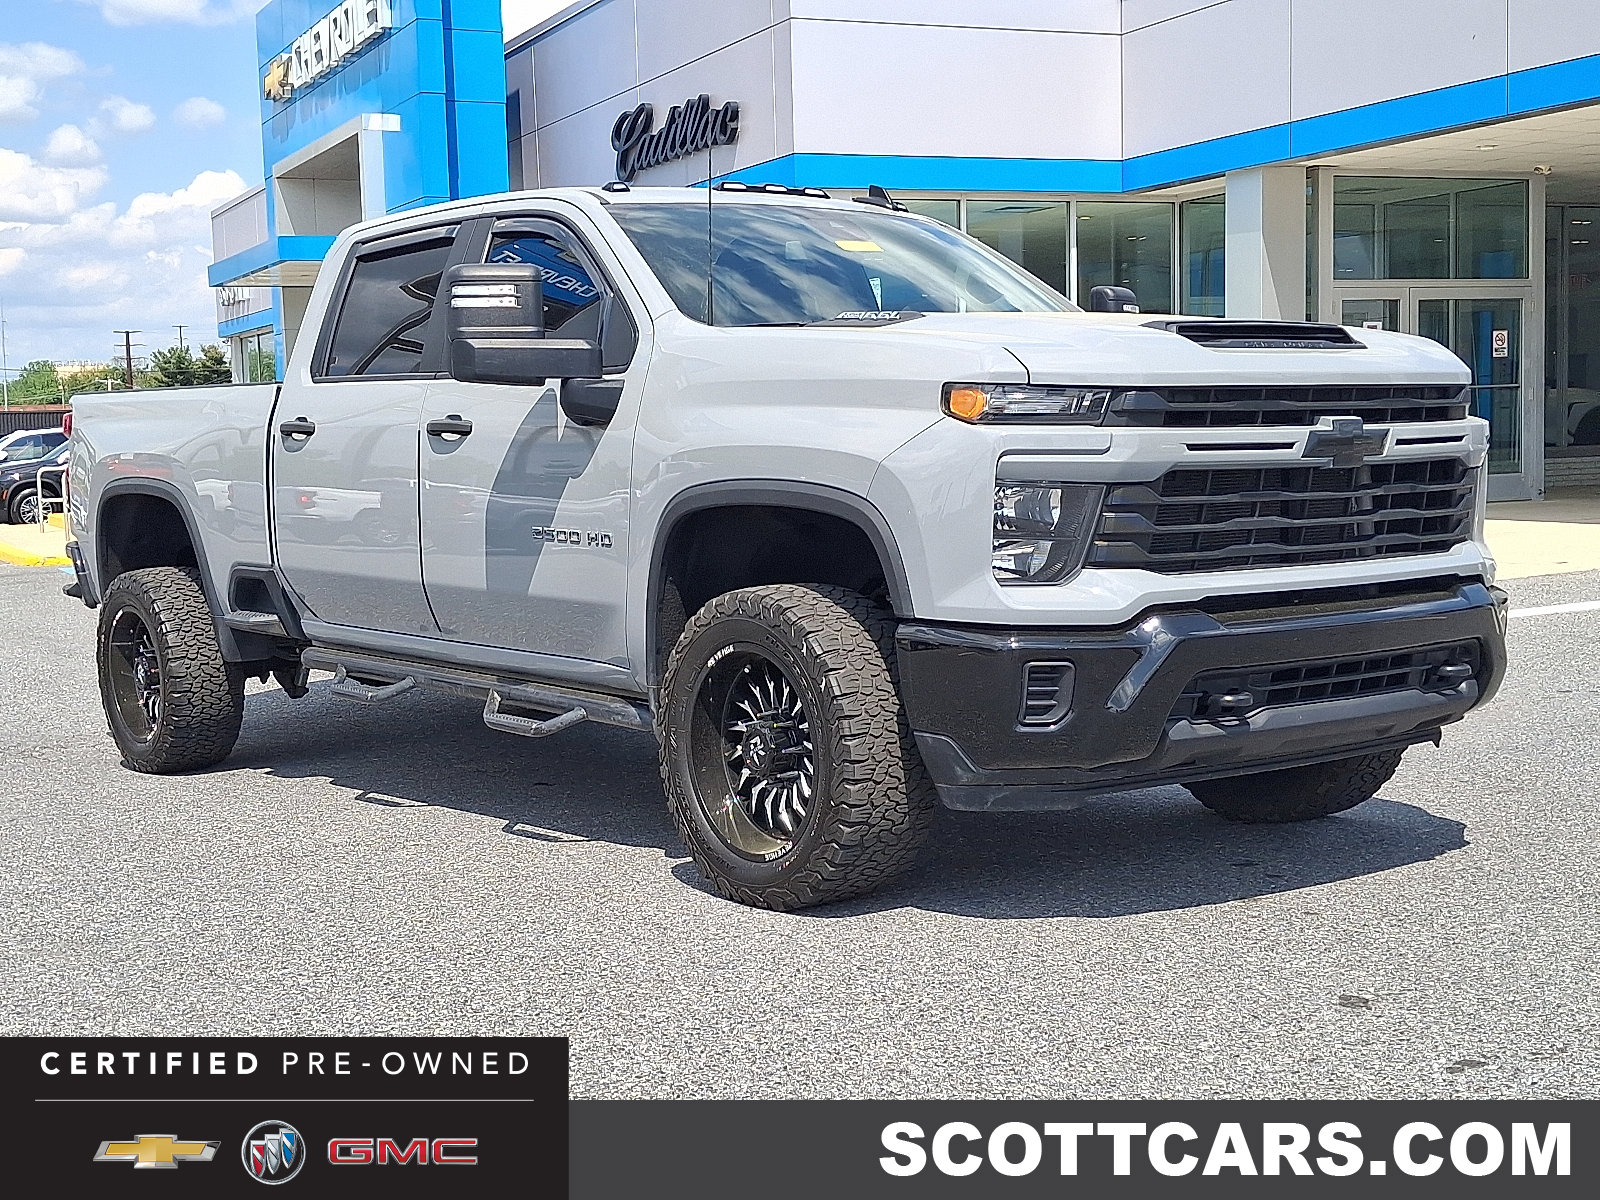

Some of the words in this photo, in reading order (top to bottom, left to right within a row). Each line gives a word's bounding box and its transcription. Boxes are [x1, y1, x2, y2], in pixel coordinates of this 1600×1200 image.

[611, 93, 739, 182] Cadillac
[531, 526, 581, 545] 2500
[586, 530, 614, 548] HD
